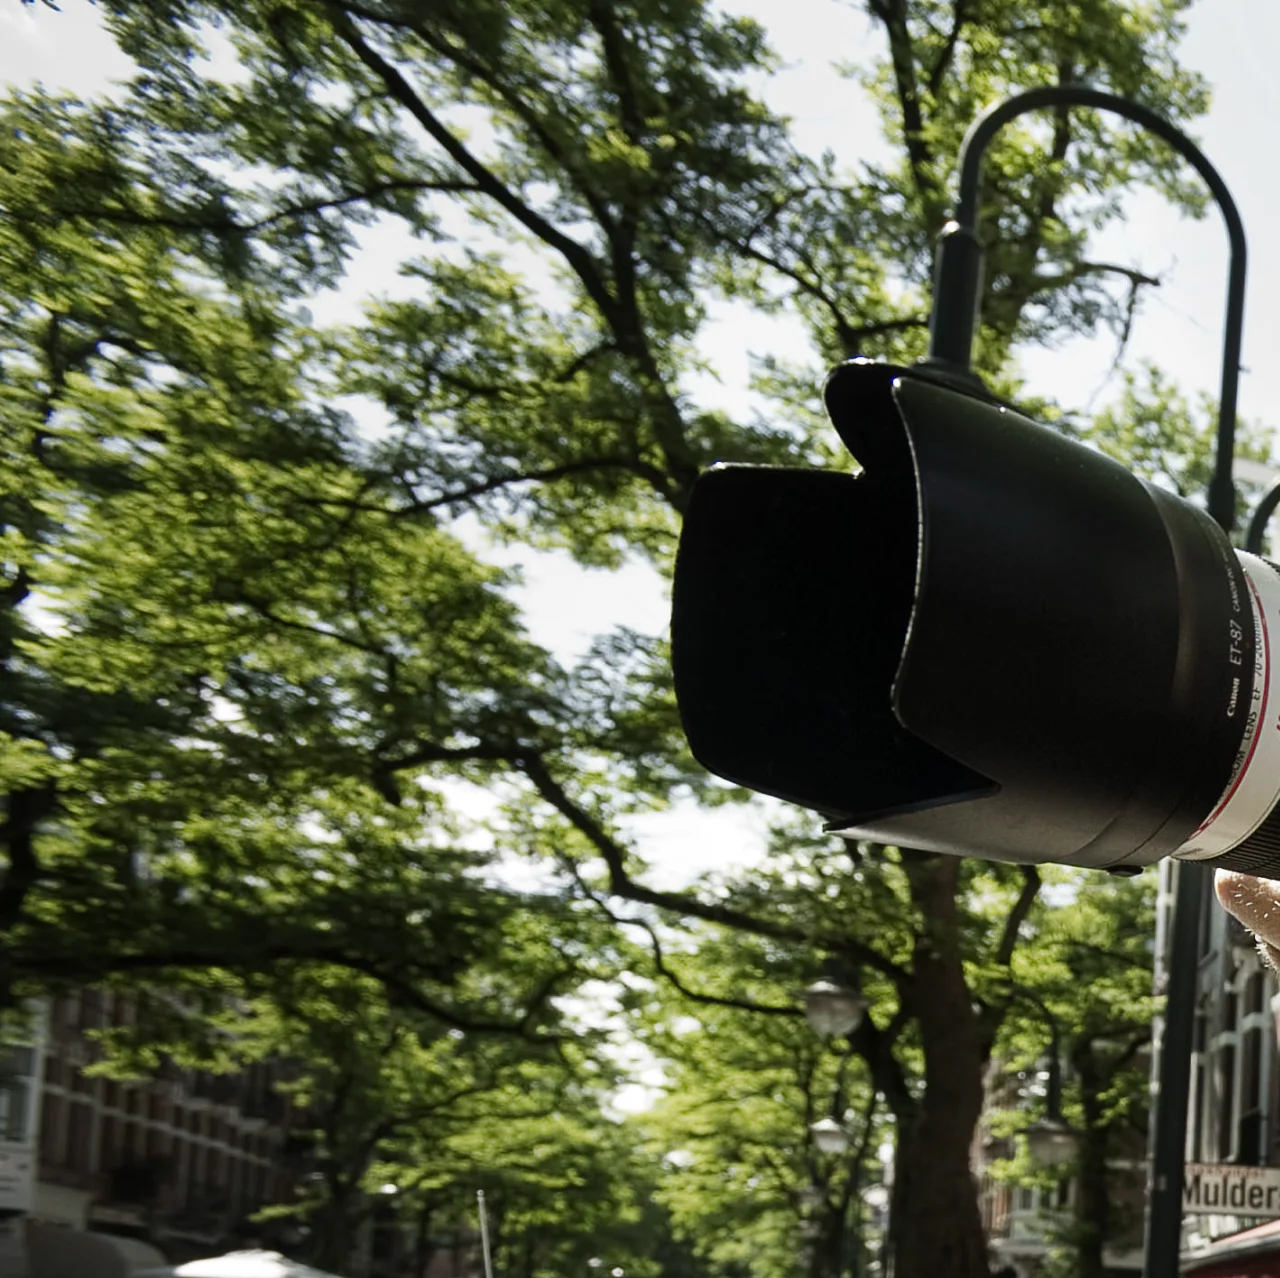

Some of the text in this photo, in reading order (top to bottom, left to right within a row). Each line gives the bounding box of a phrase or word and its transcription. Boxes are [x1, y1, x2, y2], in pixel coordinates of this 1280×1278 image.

[1227, 619, 1243, 717] Canon ET-87
[1243, 711, 1257, 740] LENS
[1182, 1174, 1279, 1210] Mulder
